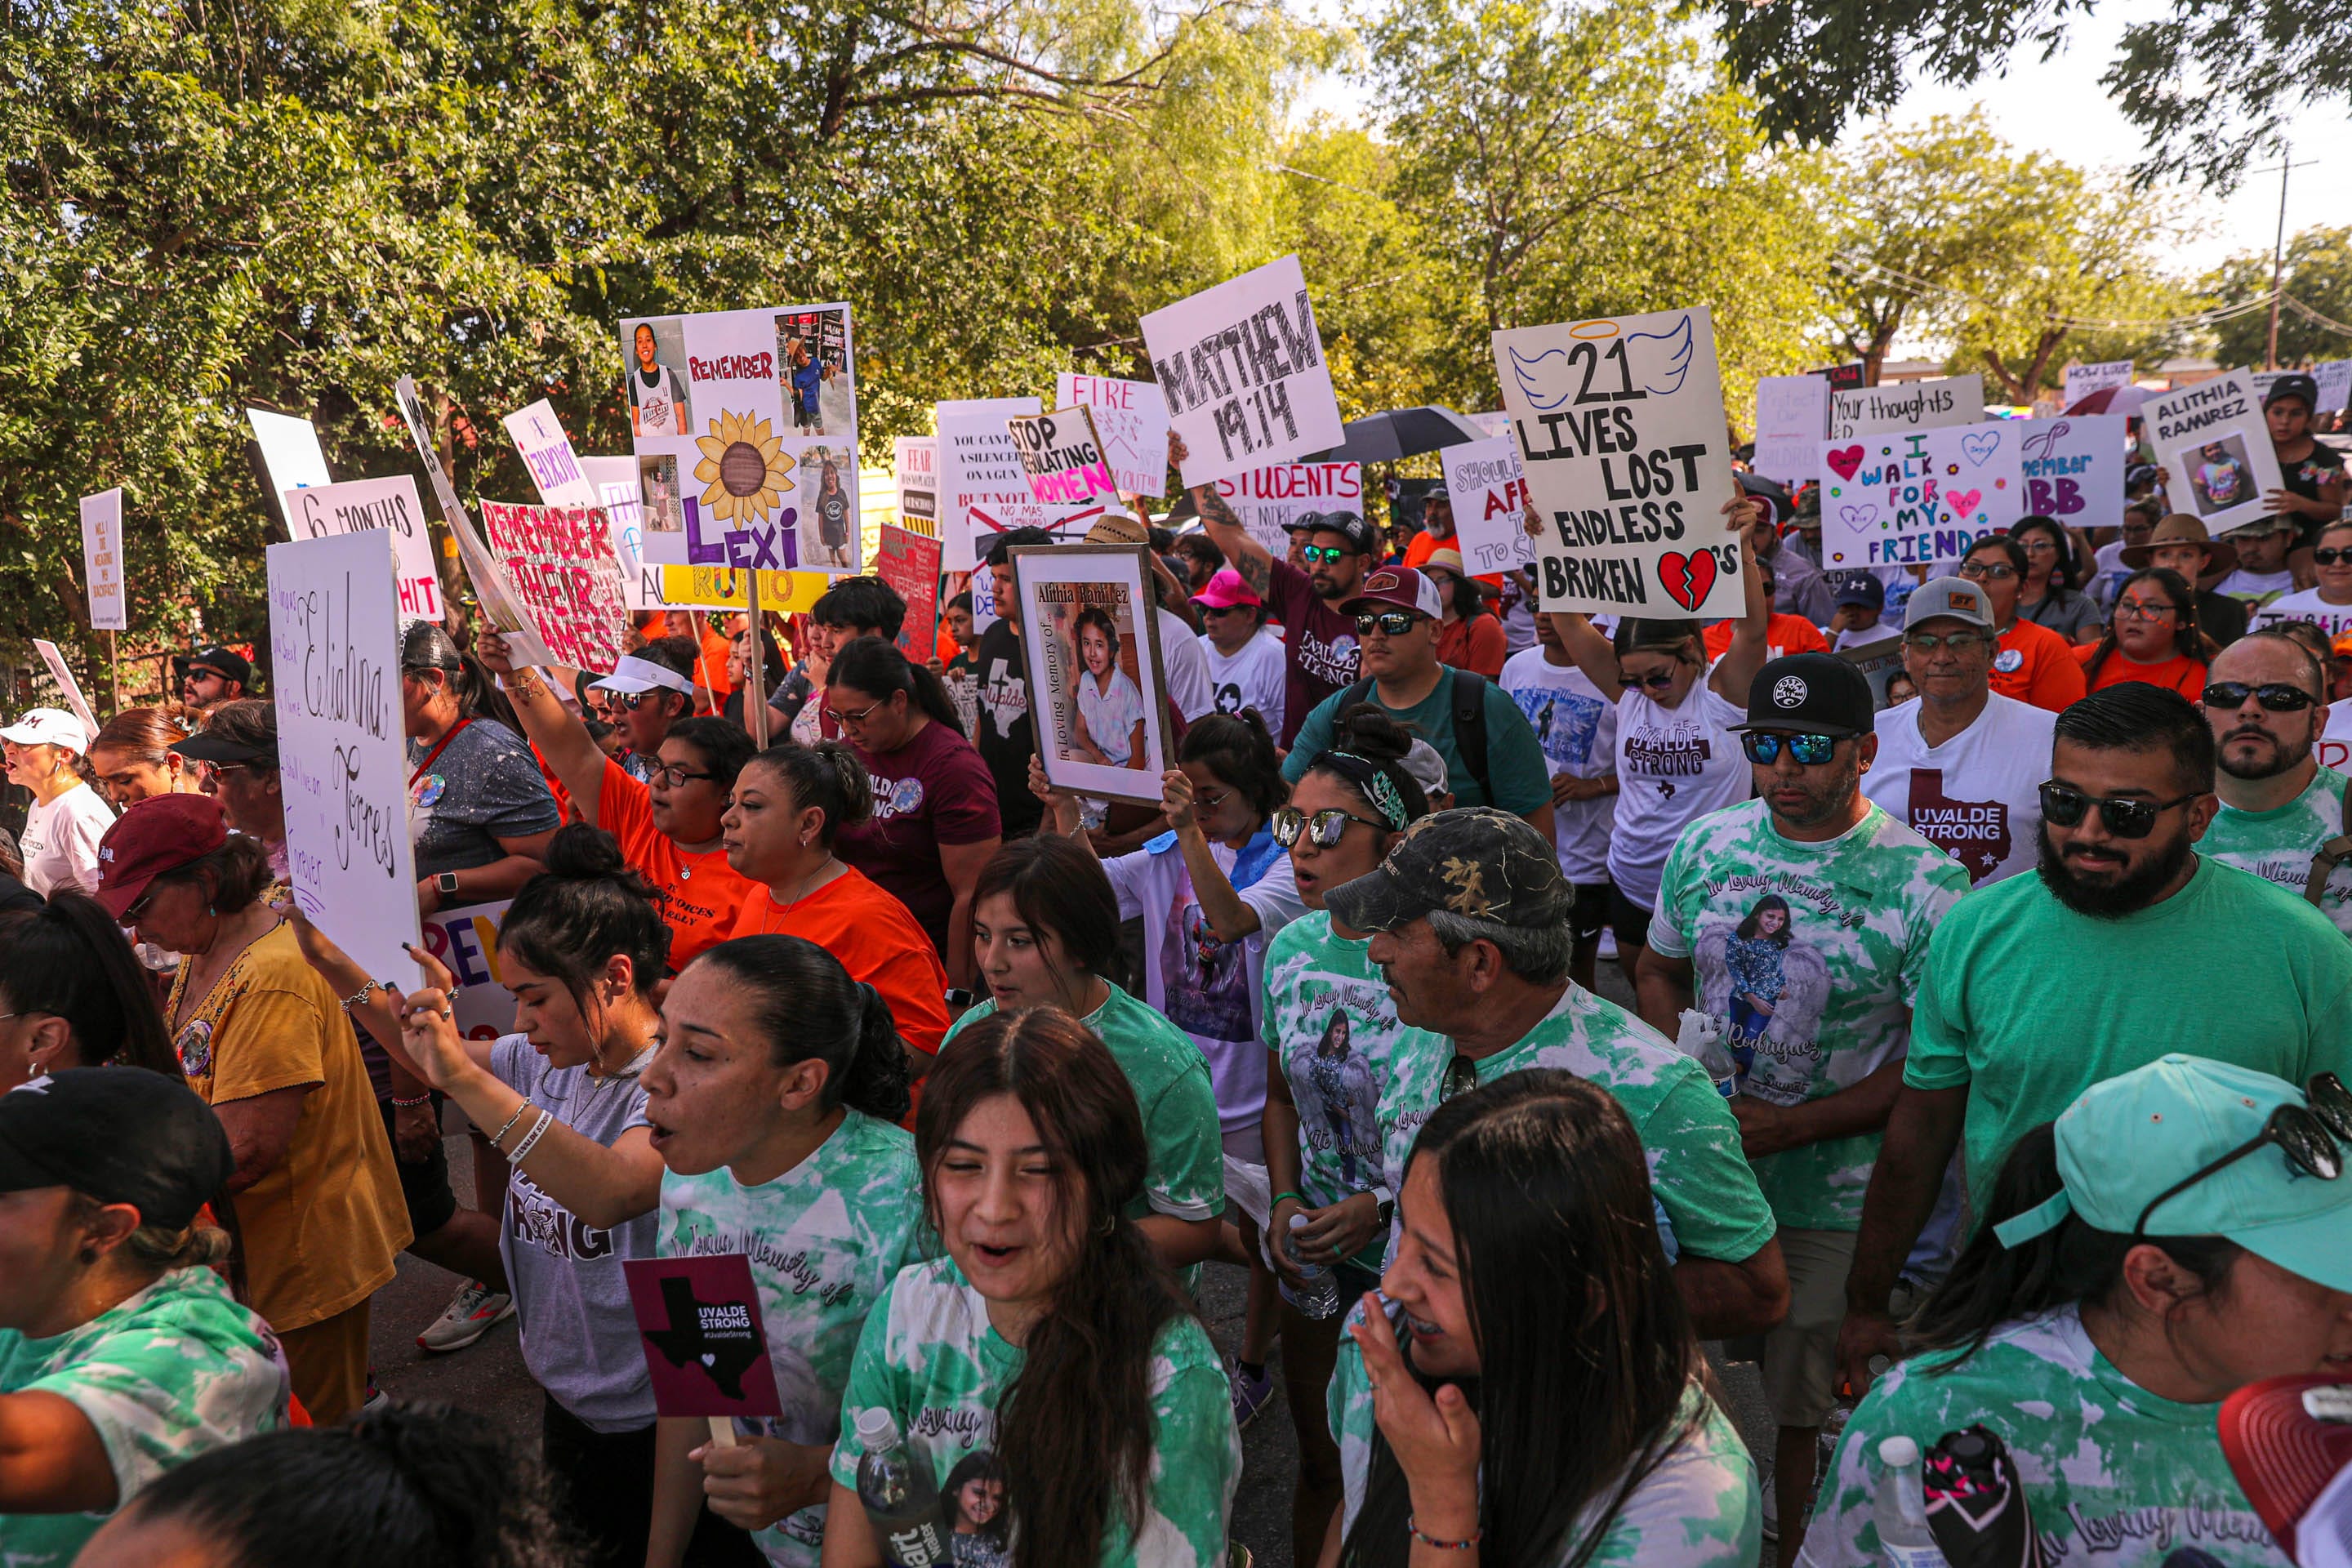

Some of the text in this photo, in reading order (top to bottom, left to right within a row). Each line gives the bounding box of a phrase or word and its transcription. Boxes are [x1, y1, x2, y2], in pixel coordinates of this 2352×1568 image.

[688, 352, 773, 383] REMEMBER
[1155, 290, 1318, 418] MATTHEW
[1567, 338, 1647, 406] 21
[1074, 376, 1136, 410] FIRE
[1834, 388, 1954, 427] Your thoughts
[2158, 381, 2242, 421] ALITHIA
[1009, 416, 1056, 451] STOP
[1212, 381, 1298, 462] 19:14
[1516, 406, 1637, 461] LIVES
[2158, 399, 2249, 440] RAMIREZ
[908, 449, 931, 472] FEAR
[955, 436, 977, 447] YOU
[979, 435, 1004, 446] CAN
[959, 455, 966, 463] A
[1904, 434, 1928, 458] I
[967, 470, 1018, 481] ON A GUN
[1025, 461, 1115, 504] WOMEN
[1218, 461, 1360, 500] STUDENTS
[1601, 444, 1706, 501] LOST
[1862, 457, 1932, 487] WALK
[958, 492, 1029, 508] BUT NOT
[1000, 506, 1044, 517] NO MAS
[1889, 479, 1940, 507] FOR
[303, 493, 412, 538] 6 MONTHS
[482, 501, 615, 560] REMEMBER
[1258, 505, 1298, 528] MORE
[1554, 501, 1685, 548] ENDLESS
[1897, 502, 1938, 532] MY
[1475, 542, 1508, 570] TO
[397, 575, 435, 615] HIT
[506, 556, 602, 618] THEIR
[1039, 582, 1129, 605] Alithia Ramirez
[1544, 556, 1647, 604] BROKEN
[297, 571, 388, 741] Eliahna
[1045, 641, 1062, 694] Memory
[1298, 645, 1356, 687] STRNG
[1777, 679, 1803, 691] COSTA
[1057, 701, 1069, 751] Loving
[1633, 725, 1700, 752] UVALDE
[1628, 748, 1704, 776] STRONG
[332, 738, 395, 879] Torres
[1914, 808, 2001, 824] UVALDE
[1914, 823, 2000, 840] STRONG
[1704, 869, 1866, 927] In Loving Memory of
[1300, 999, 1312, 1018] In
[1313, 987, 1340, 1012] Loving
[1342, 983, 1382, 1023] Memory
[1726, 1022, 1823, 1063] Rodriguez
[1398, 1103, 1432, 1131] Lovin
[518, 1131, 539, 1155] UVALDE
[691, 1223, 734, 1256] Loving
[740, 1227, 820, 1295] Memory
[698, 1306, 748, 1319] UVALDE
[700, 1316, 751, 1330] STRONG
[704, 1330, 752, 1339] #UvaldeStrong
[2063, 1500, 2176, 1552] Loving
[889, 1527, 931, 1568] art
